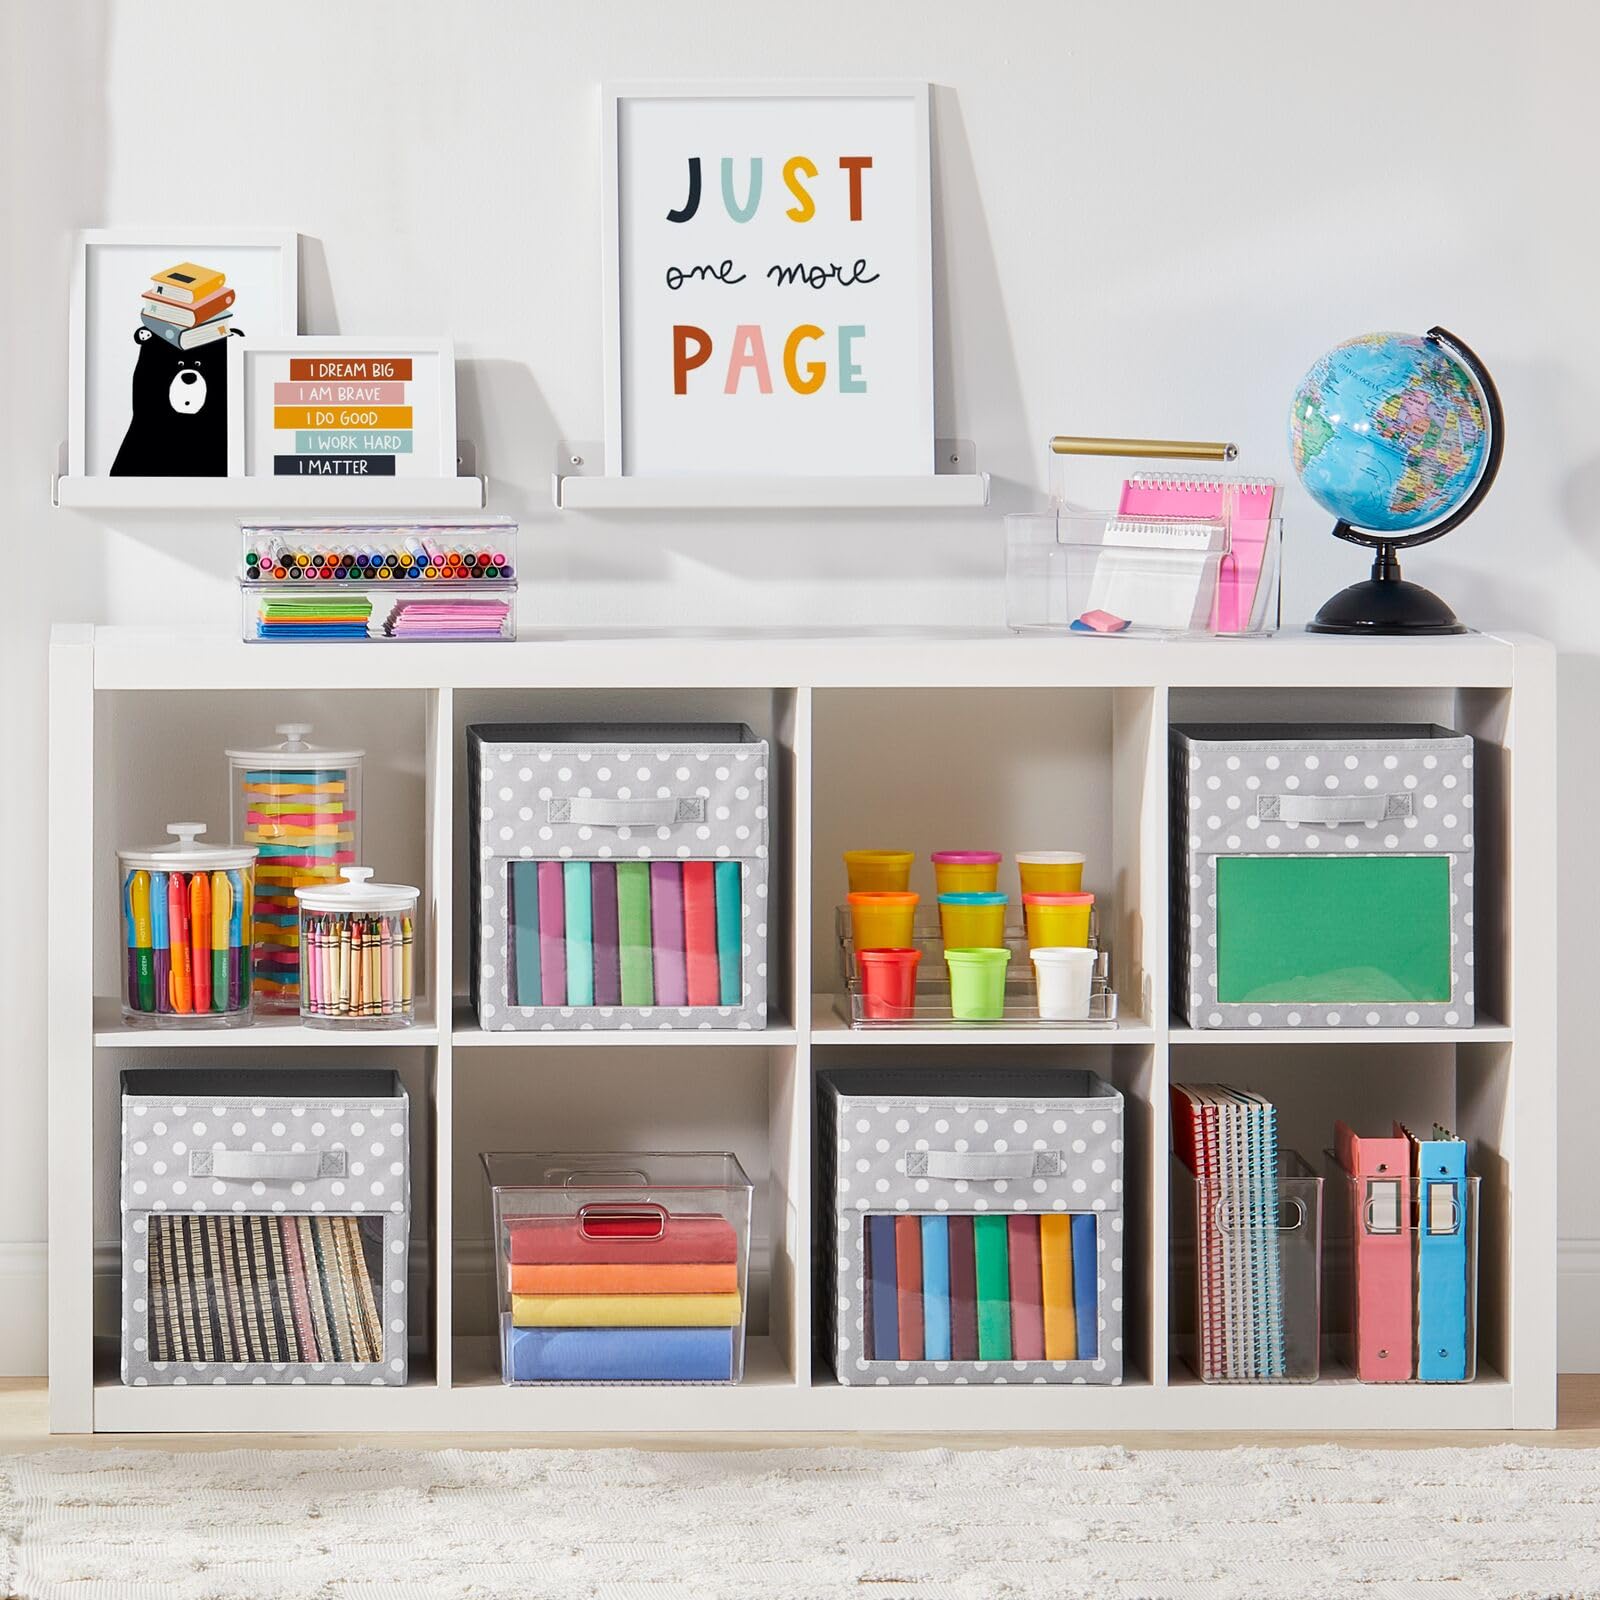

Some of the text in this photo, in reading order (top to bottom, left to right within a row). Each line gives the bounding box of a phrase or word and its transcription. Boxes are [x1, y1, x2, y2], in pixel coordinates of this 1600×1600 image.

[666, 156, 873, 224] JUST
[666, 258, 881, 290] one more
[672, 323, 867, 395] PAGE
[310, 363, 394, 378] I DREAM BIG
[300, 387, 382, 402] I AM BRAVE
[306, 411, 379, 426] I DO GOOD
[308, 435, 402, 451] I WORK HARD
[299, 460, 369, 475] I MATTER
